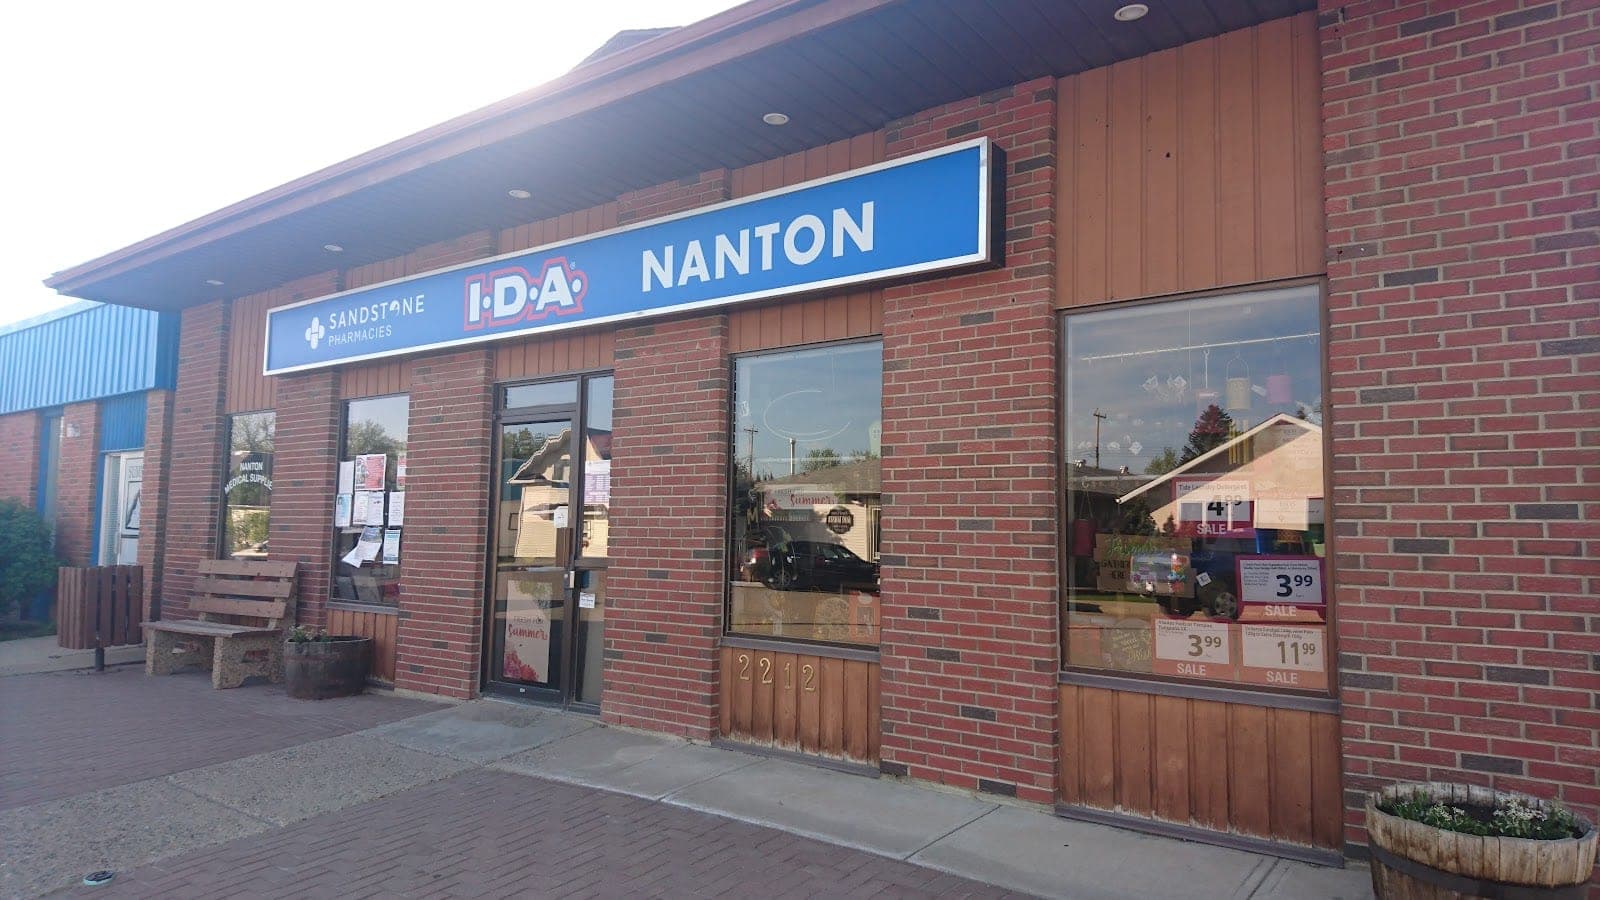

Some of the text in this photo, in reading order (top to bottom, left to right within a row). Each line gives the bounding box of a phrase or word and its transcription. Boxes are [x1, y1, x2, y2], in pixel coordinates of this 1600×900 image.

[641, 200, 875, 292] NANTON
[329, 294, 425, 330] SANDSTONE
[328, 324, 392, 347] PHARMACIES
[240, 461, 264, 471] NANTON
[224, 473, 249, 495] MEDICAL
[790, 493, 835, 507] Summer
[1196, 523, 1227, 535] SALE
[1264, 604, 1297, 617] SALE
[508, 623, 548, 640] Summer
[738, 654, 816, 692] 2212
[1177, 663, 1207, 676] SALE
[1266, 670, 1299, 685] SALE
